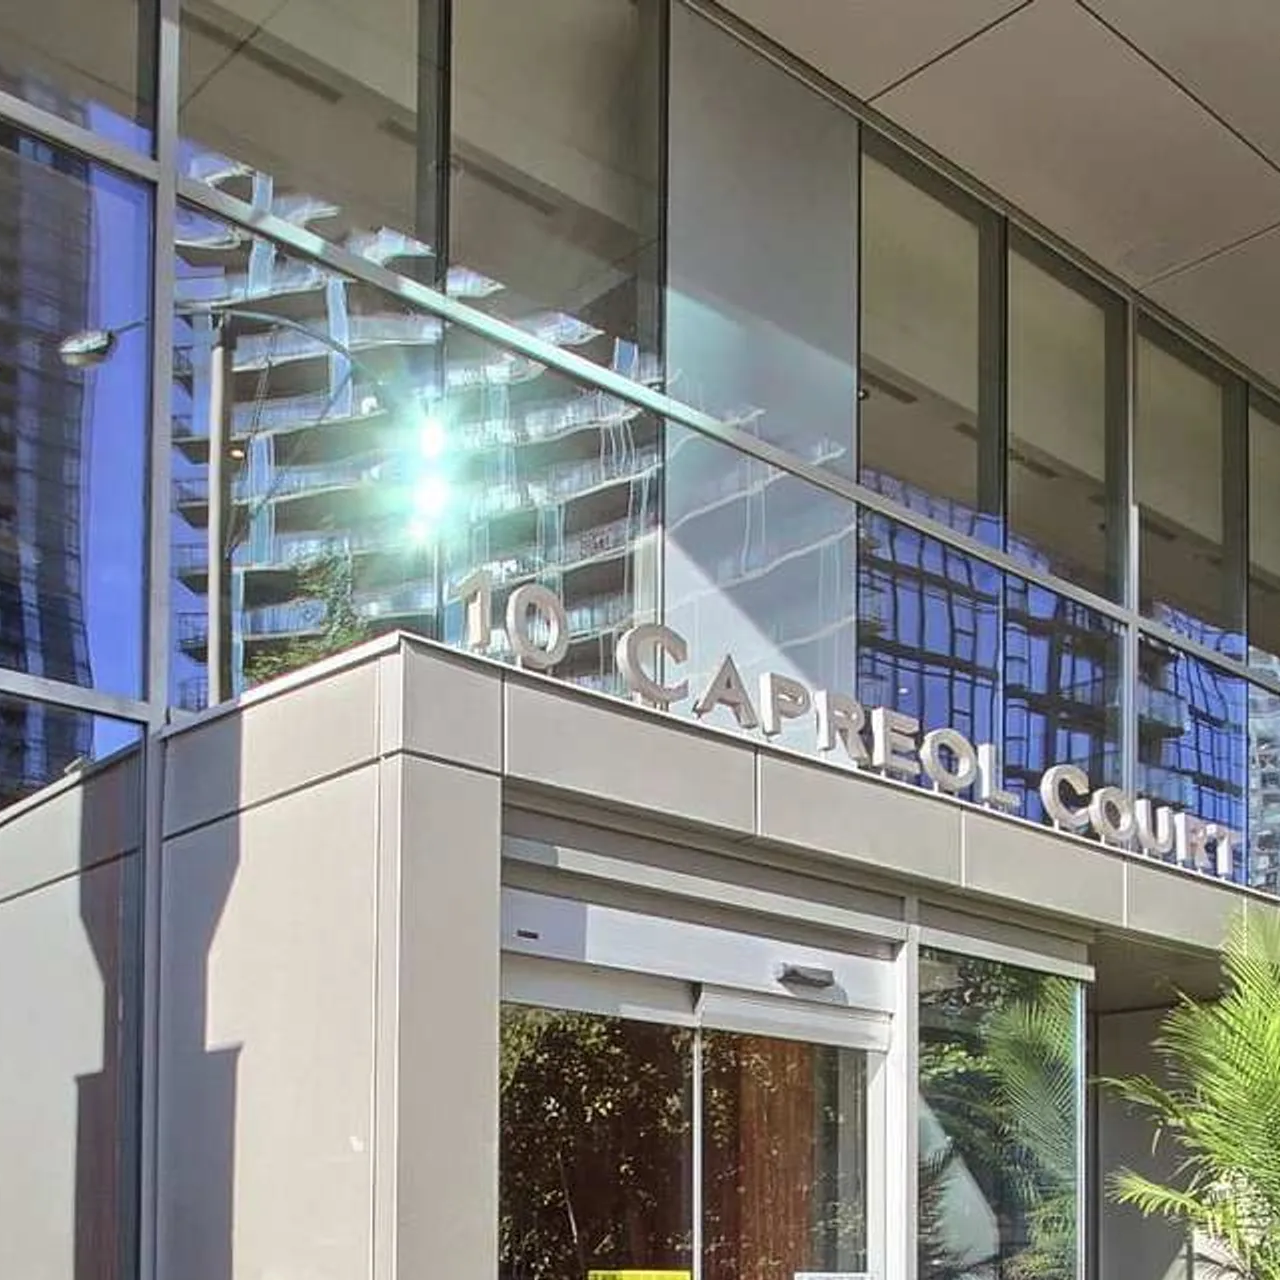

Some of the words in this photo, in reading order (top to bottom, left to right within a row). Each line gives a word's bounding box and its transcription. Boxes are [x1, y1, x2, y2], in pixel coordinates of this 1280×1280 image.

[457, 566, 570, 671] 10
[616, 622, 1021, 807] CAPREOL
[1040, 763, 1244, 877] COURT
